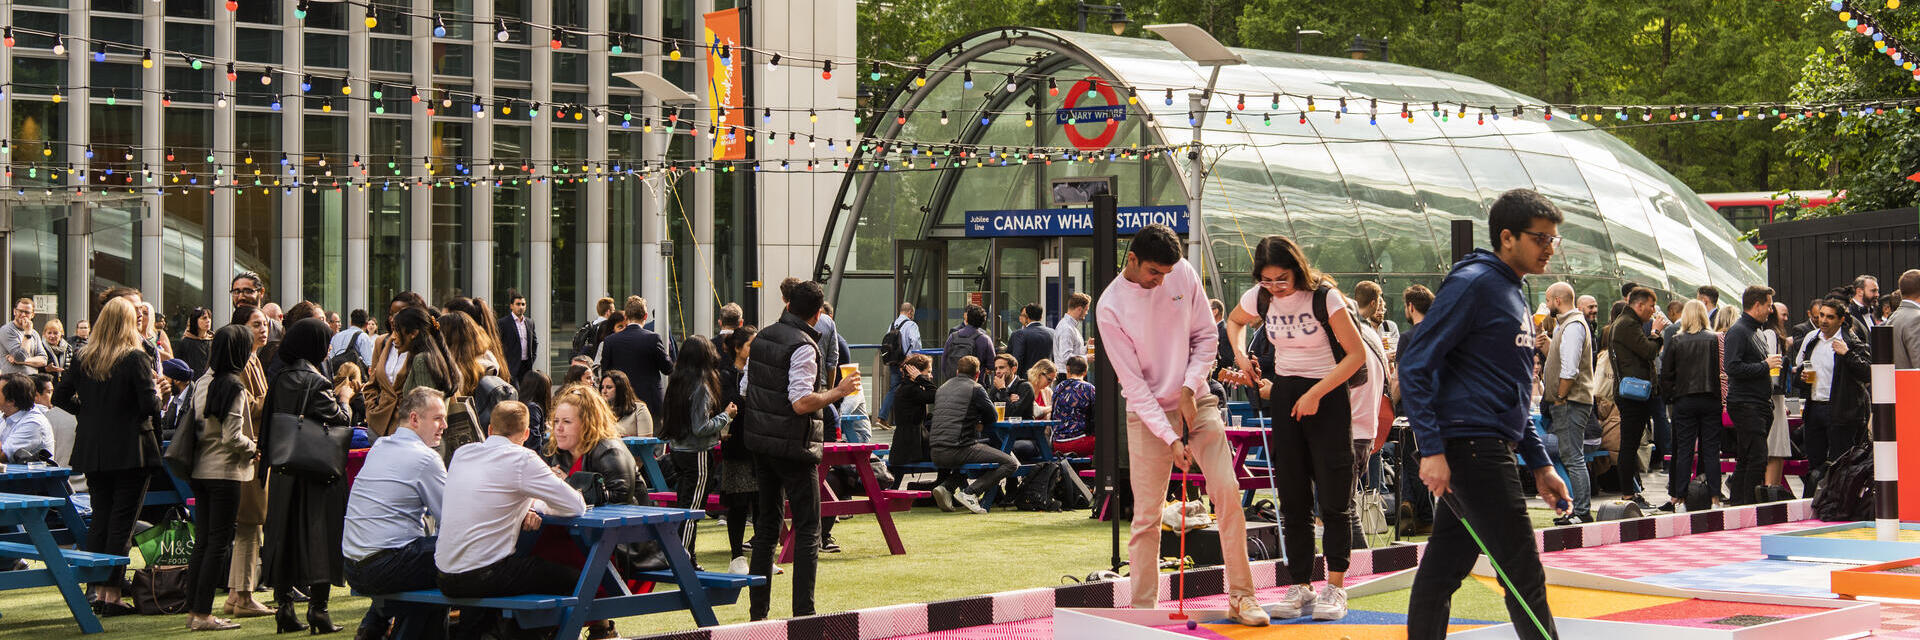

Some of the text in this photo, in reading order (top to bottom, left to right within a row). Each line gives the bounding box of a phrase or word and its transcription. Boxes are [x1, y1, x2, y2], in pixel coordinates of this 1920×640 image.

[993, 215, 1051, 231] CANARY
[1057, 214, 1094, 229] WHA
[1116, 212, 1177, 228] STATION
[160, 540, 194, 556] M&S
